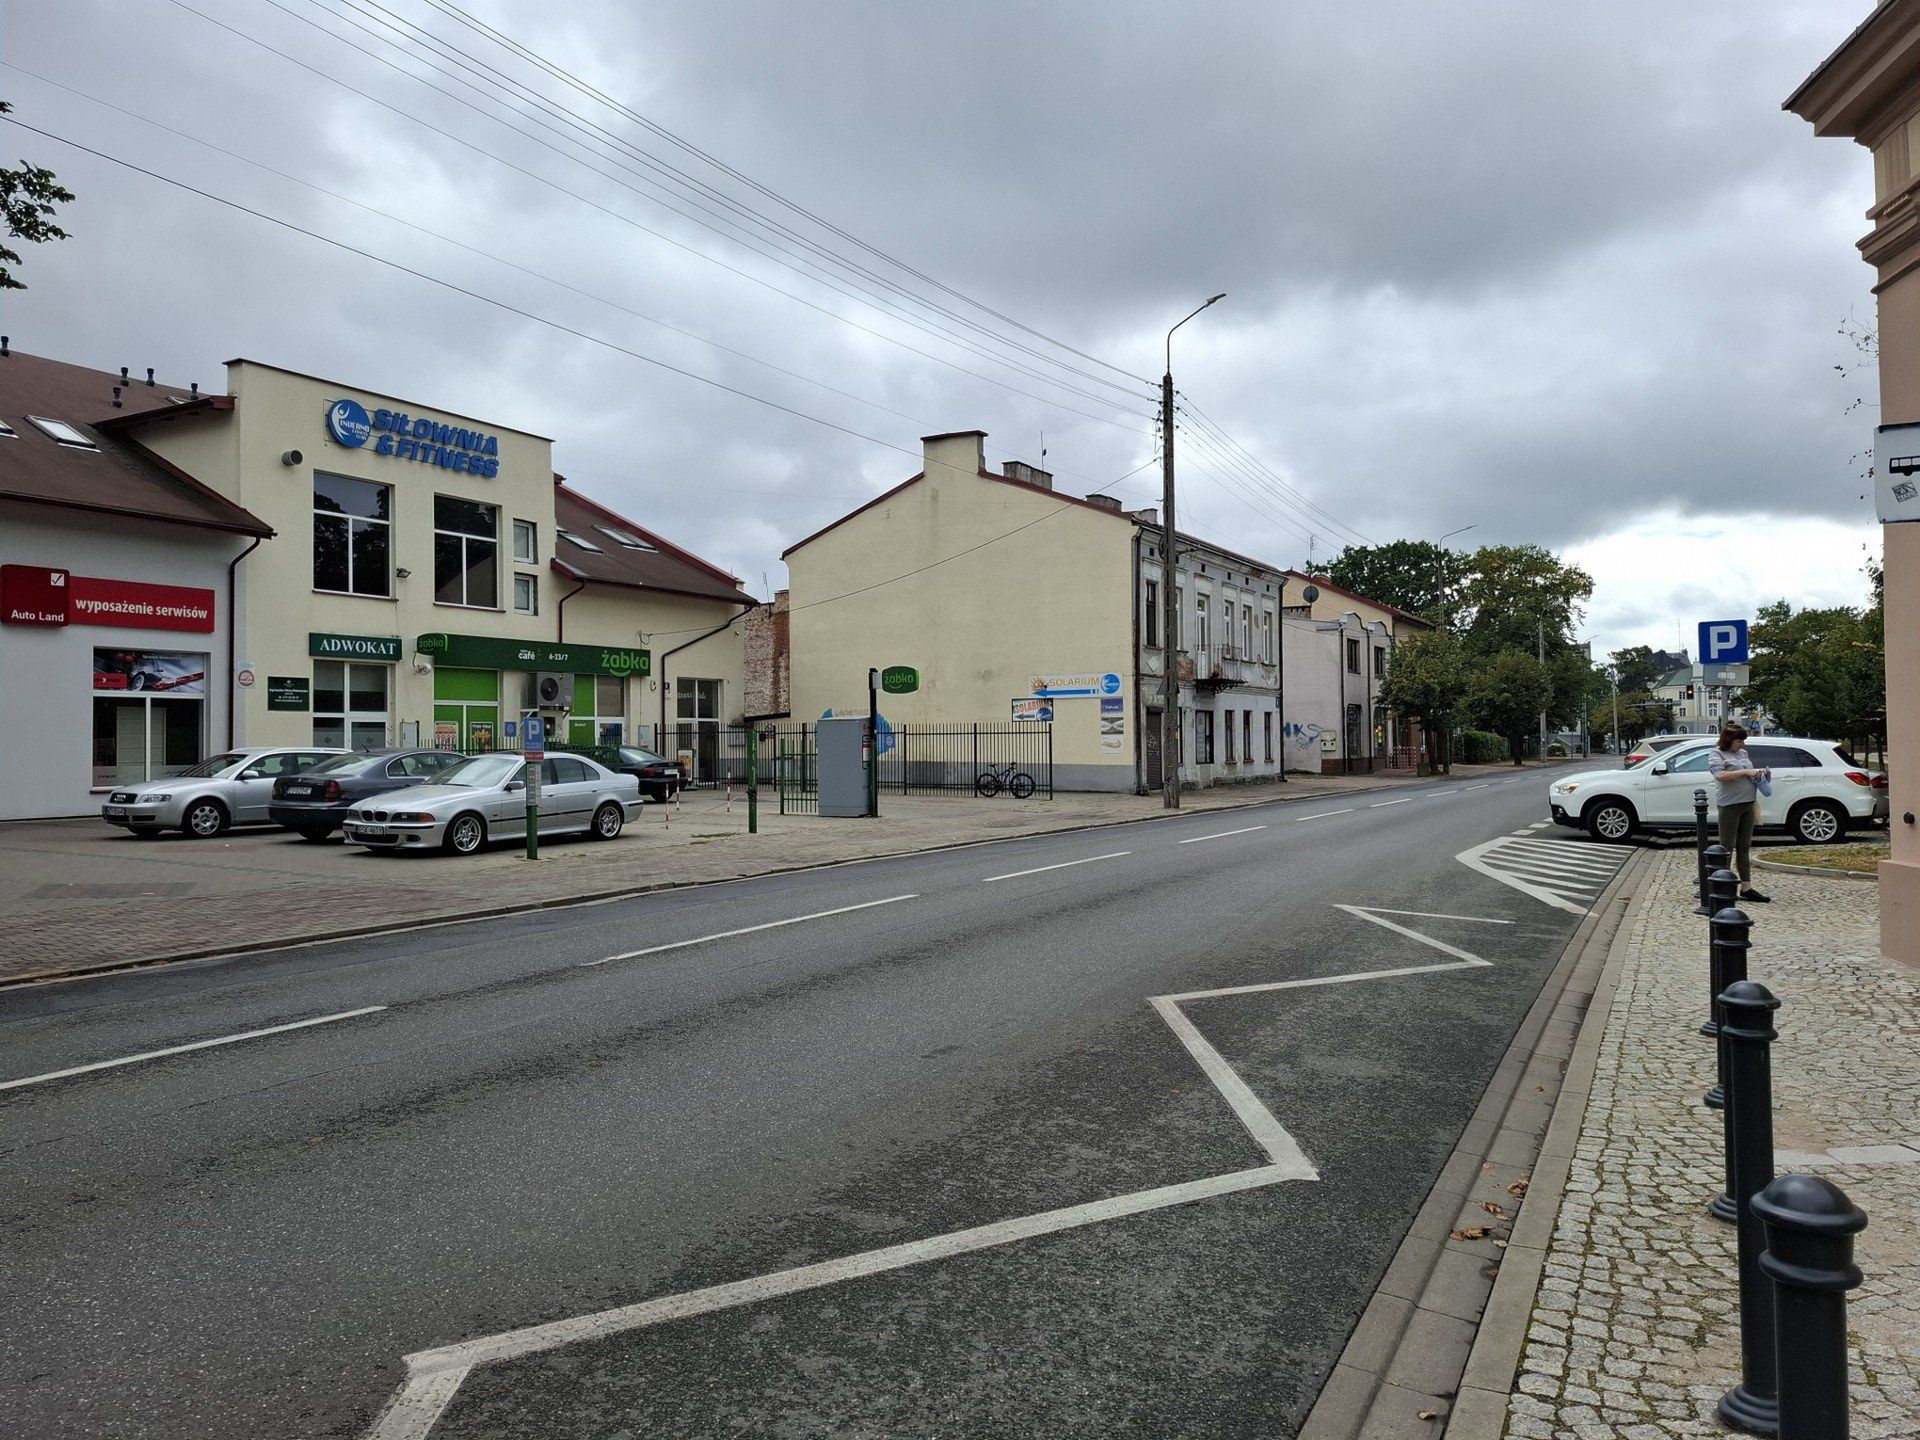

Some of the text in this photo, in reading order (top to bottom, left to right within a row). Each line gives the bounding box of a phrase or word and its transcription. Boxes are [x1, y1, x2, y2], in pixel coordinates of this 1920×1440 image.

[373, 408, 499, 456] SIŁOWNIA
[11, 609, 65, 622] Auto Land
[75, 598, 208, 619] wyposażenie serwisów
[319, 638, 397, 655] ADWOKAT
[1709, 625, 1738, 659] P
[601, 650, 649, 670] żabka
[884, 672, 914, 685] żabka
[1048, 677, 1099, 687] SOLARIUM
[528, 720, 540, 740] P
